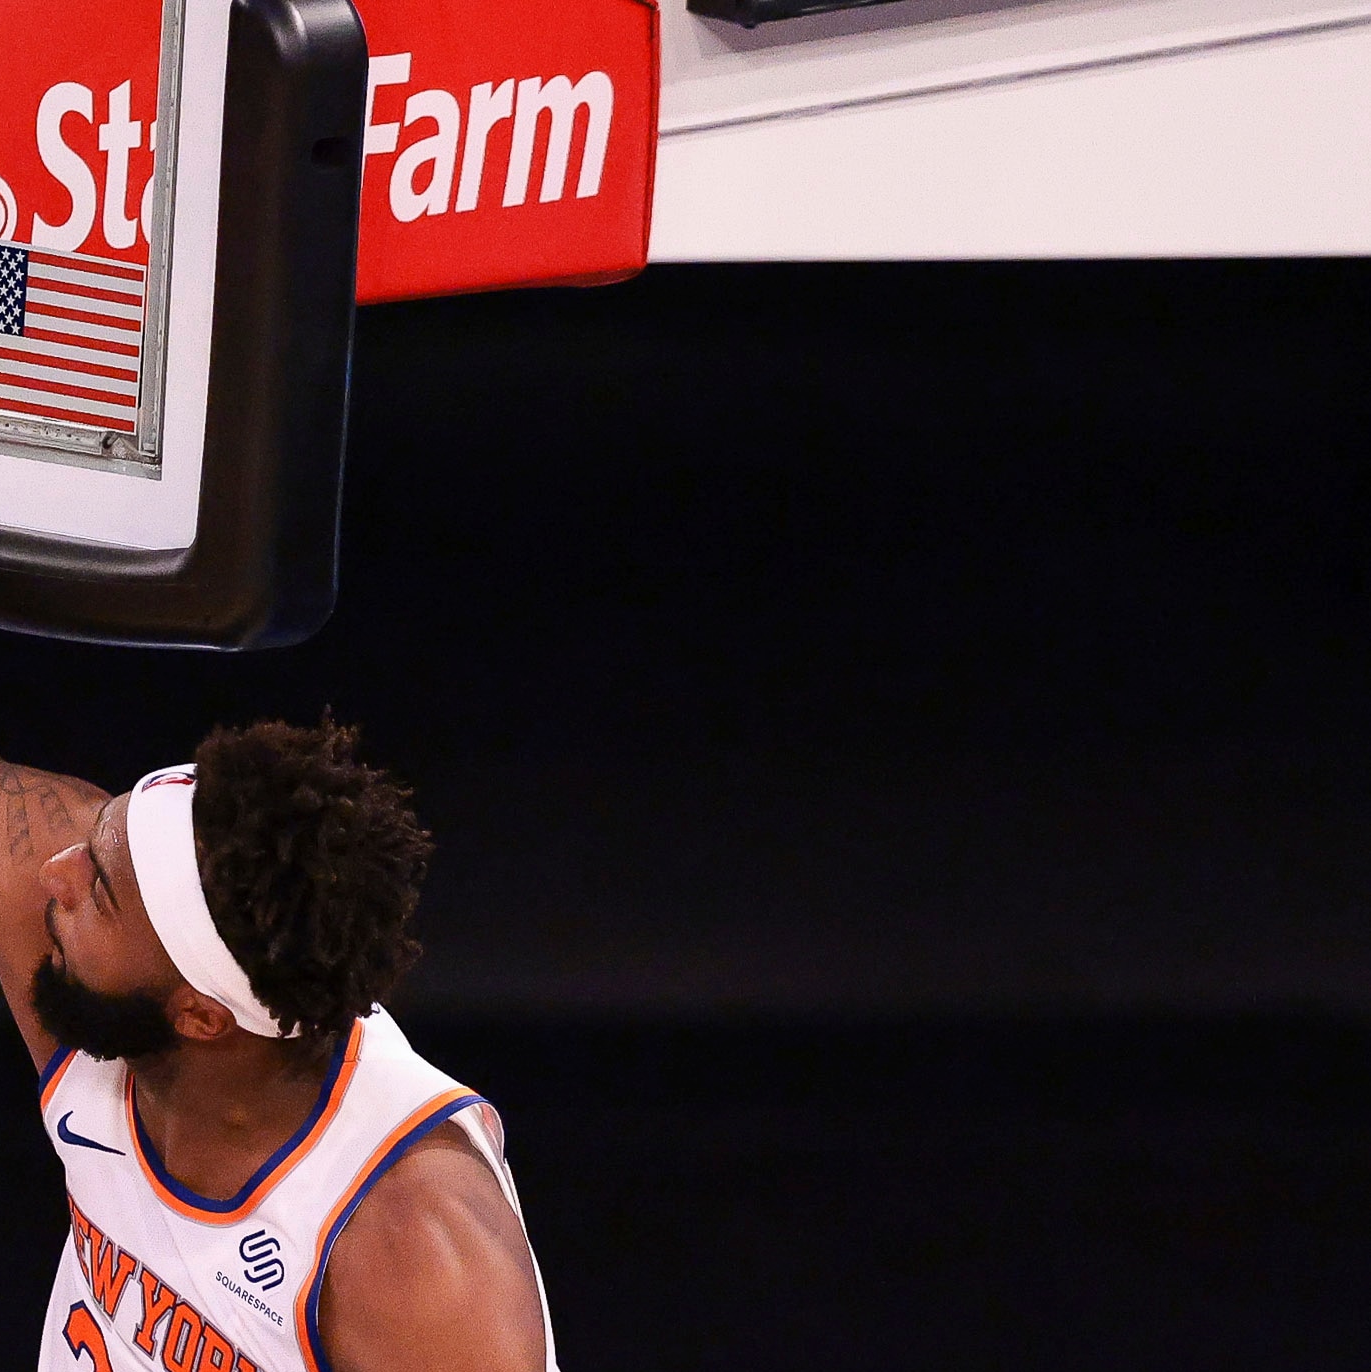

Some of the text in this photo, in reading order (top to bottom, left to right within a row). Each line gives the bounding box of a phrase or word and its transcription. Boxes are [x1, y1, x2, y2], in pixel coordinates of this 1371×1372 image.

[363, 52, 615, 223] Farm
[68, 1194, 137, 1322] EW
[215, 1271, 284, 1327] SQUARESPACE
